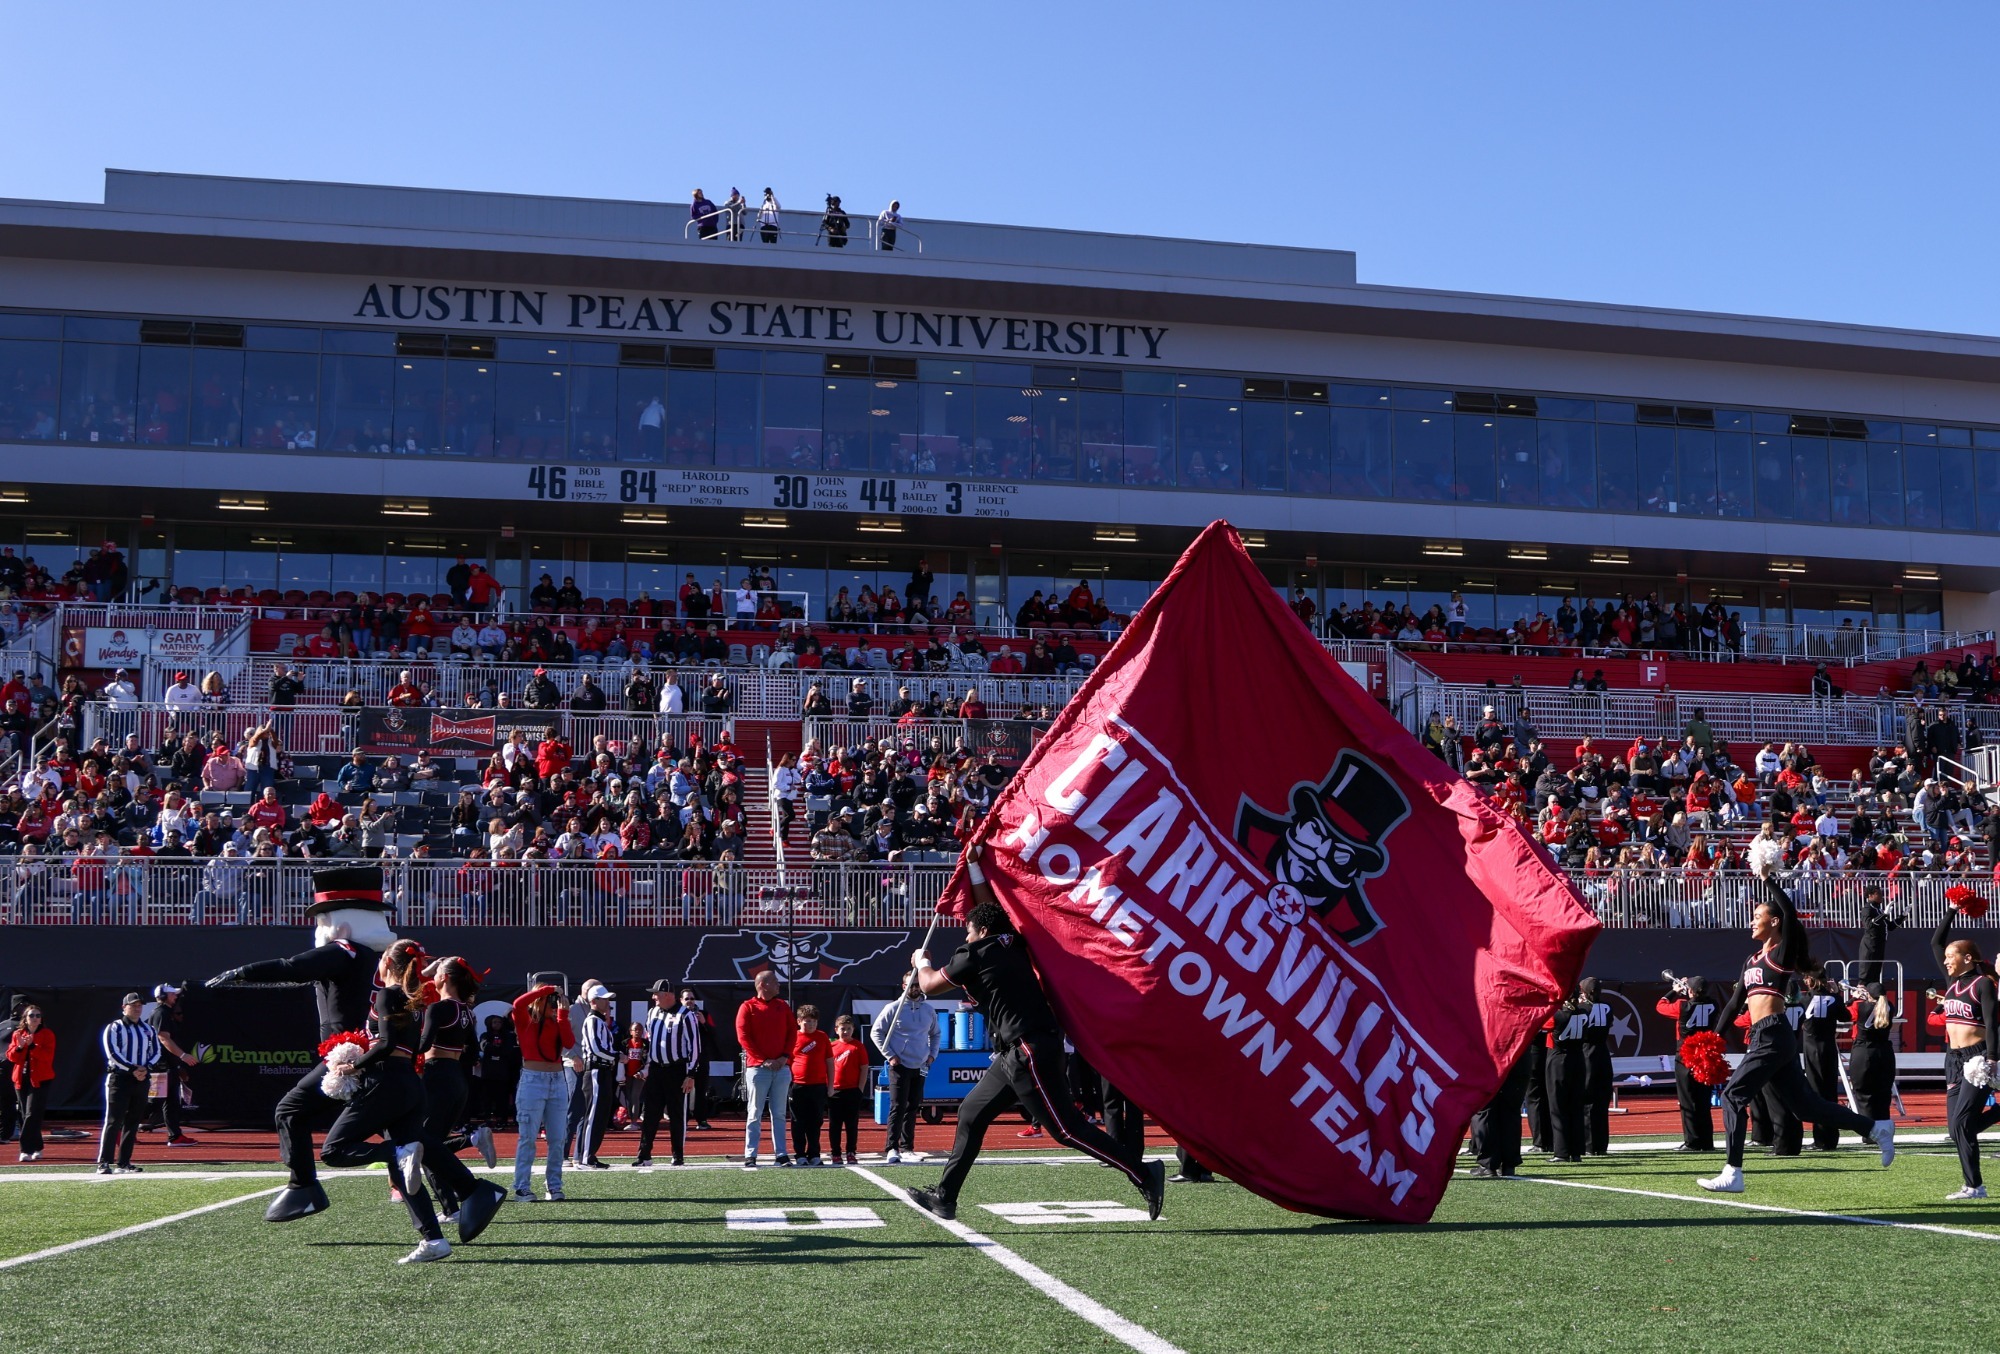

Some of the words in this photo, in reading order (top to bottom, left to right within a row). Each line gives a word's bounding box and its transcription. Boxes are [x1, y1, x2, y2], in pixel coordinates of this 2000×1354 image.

[353, 282, 548, 326] AUSTIN
[567, 293, 692, 333] PEAY
[708, 300, 855, 342] STATE
[872, 309, 1169, 360] UNIVERSITY
[579, 467, 600, 476] BOB
[682, 471, 730, 482] HAROLD
[528, 465, 567, 500] 46
[574, 479, 605, 489] BIBLE
[620, 469, 657, 504] 84
[815, 476, 845, 487] JOHN
[911, 480, 928, 491] JAY
[699, 485, 749, 496] ROBERTS
[773, 475, 808, 509] 30
[813, 488, 848, 499] OGLES
[859, 478, 897, 512] 44
[966, 483, 1019, 495] TERRENCE
[571, 492, 608, 501] 1975-77
[689, 496, 723, 506] 1967-70
[902, 492, 938, 503] BAILEY
[945, 482, 962, 515] 3
[978, 495, 1007, 506] HOLT
[812, 500, 849, 511] 1963-66
[901, 504, 938, 515] 2000-02
[974, 507, 1010, 518] 2007-10
[162, 632, 202, 644] GARY
[65, 637, 79, 657] C
[160, 643, 205, 652] MATHEWS
[98, 647, 139, 662] Wendy's
[1372, 672, 1383, 690] F
[1646, 667, 1658, 683] F
[435, 724, 491, 736] Budweiser
[1044, 732, 1443, 1155] CLARKSVILLE'S
[1004, 813, 1293, 1077] HOMETOWN
[1290, 1061, 1418, 1206] TEAM
[1805, 995, 1835, 1019] AP
[1944, 999, 1974, 1020] GOVS
[1588, 1003, 1611, 1028] AP
[1686, 1003, 1715, 1029] AP
[1559, 1013, 1588, 1041] AP
[216, 1044, 312, 1064] Tennova
[259, 1066, 312, 1075] Healthcare
